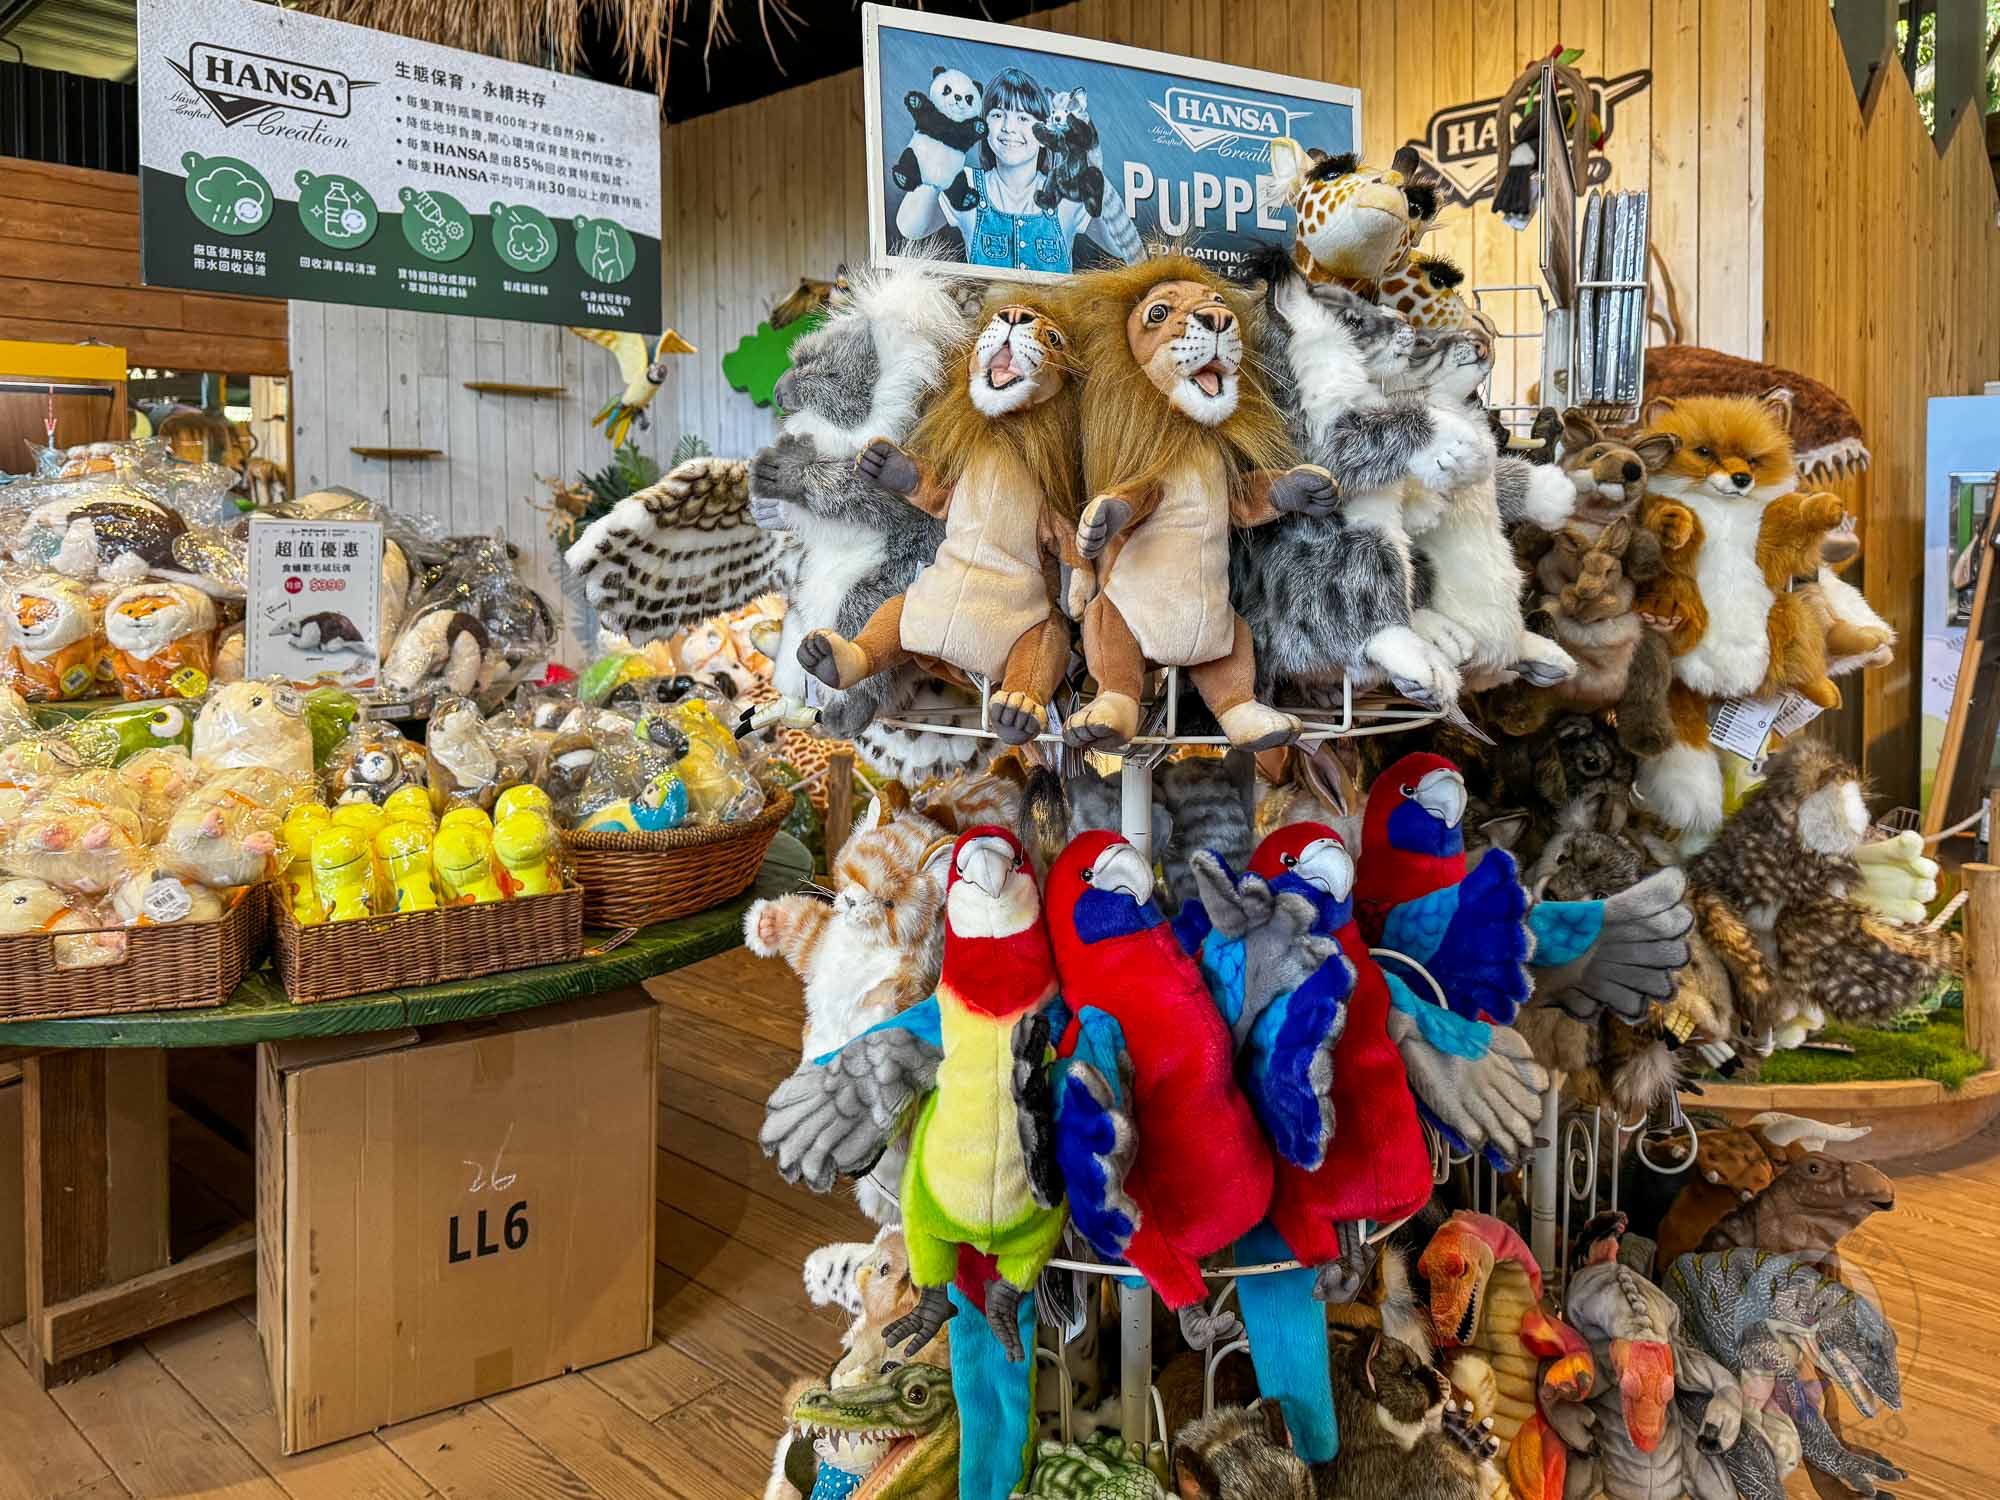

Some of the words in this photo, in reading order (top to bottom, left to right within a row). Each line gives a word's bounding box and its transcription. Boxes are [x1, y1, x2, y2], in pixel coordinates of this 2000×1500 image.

[243, 110, 349, 149] Creation
[1177, 97, 1279, 134] HANSA
[1207, 135, 1272, 163] Creati
[300, 173, 310, 186] 2
[404, 190, 412, 201] 3
[1123, 160, 1288, 237] PUPPE
[587, 302, 625, 317] HANSA
[275, 540, 360, 559] 超值優惠
[448, 1200, 529, 1264] LL6
